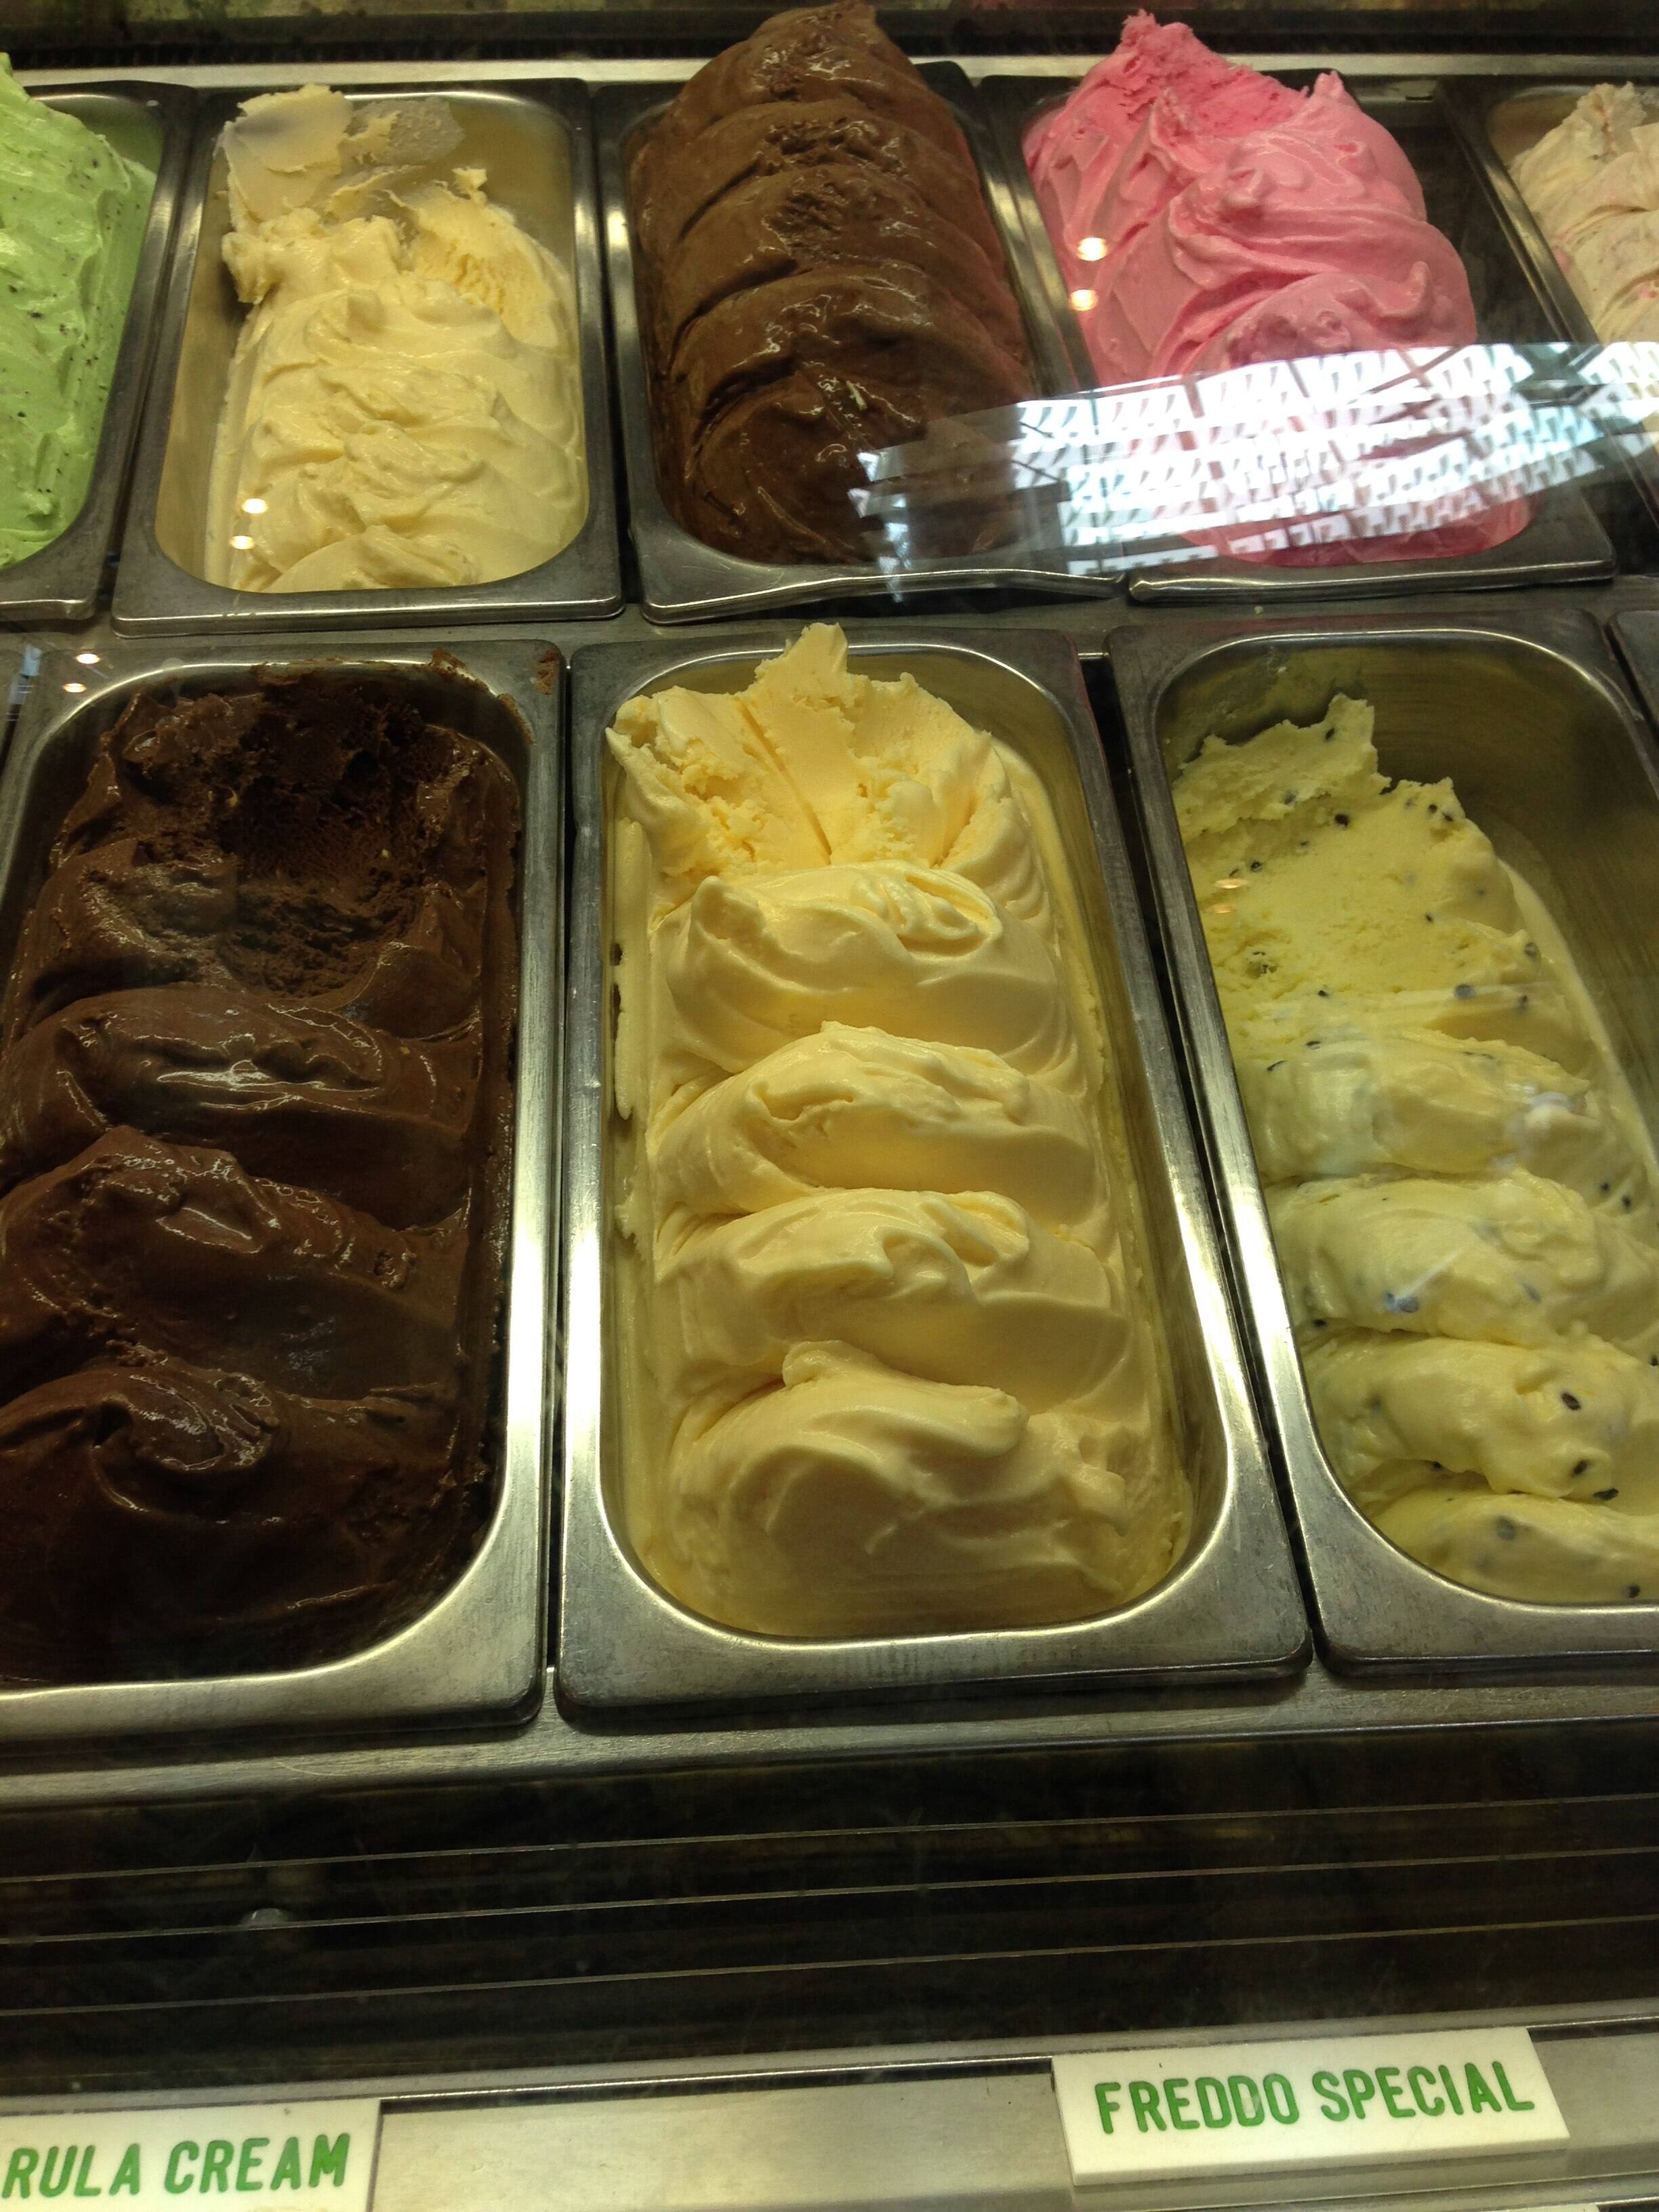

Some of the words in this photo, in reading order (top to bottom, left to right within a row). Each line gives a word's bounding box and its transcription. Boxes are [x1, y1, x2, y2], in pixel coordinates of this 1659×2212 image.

[1094, 2072, 1300, 2135] FREDDO
[1312, 2060, 1536, 2123] SPECIAL
[1, 2143, 141, 2199] RULA
[163, 2132, 352, 2194] CREAM
